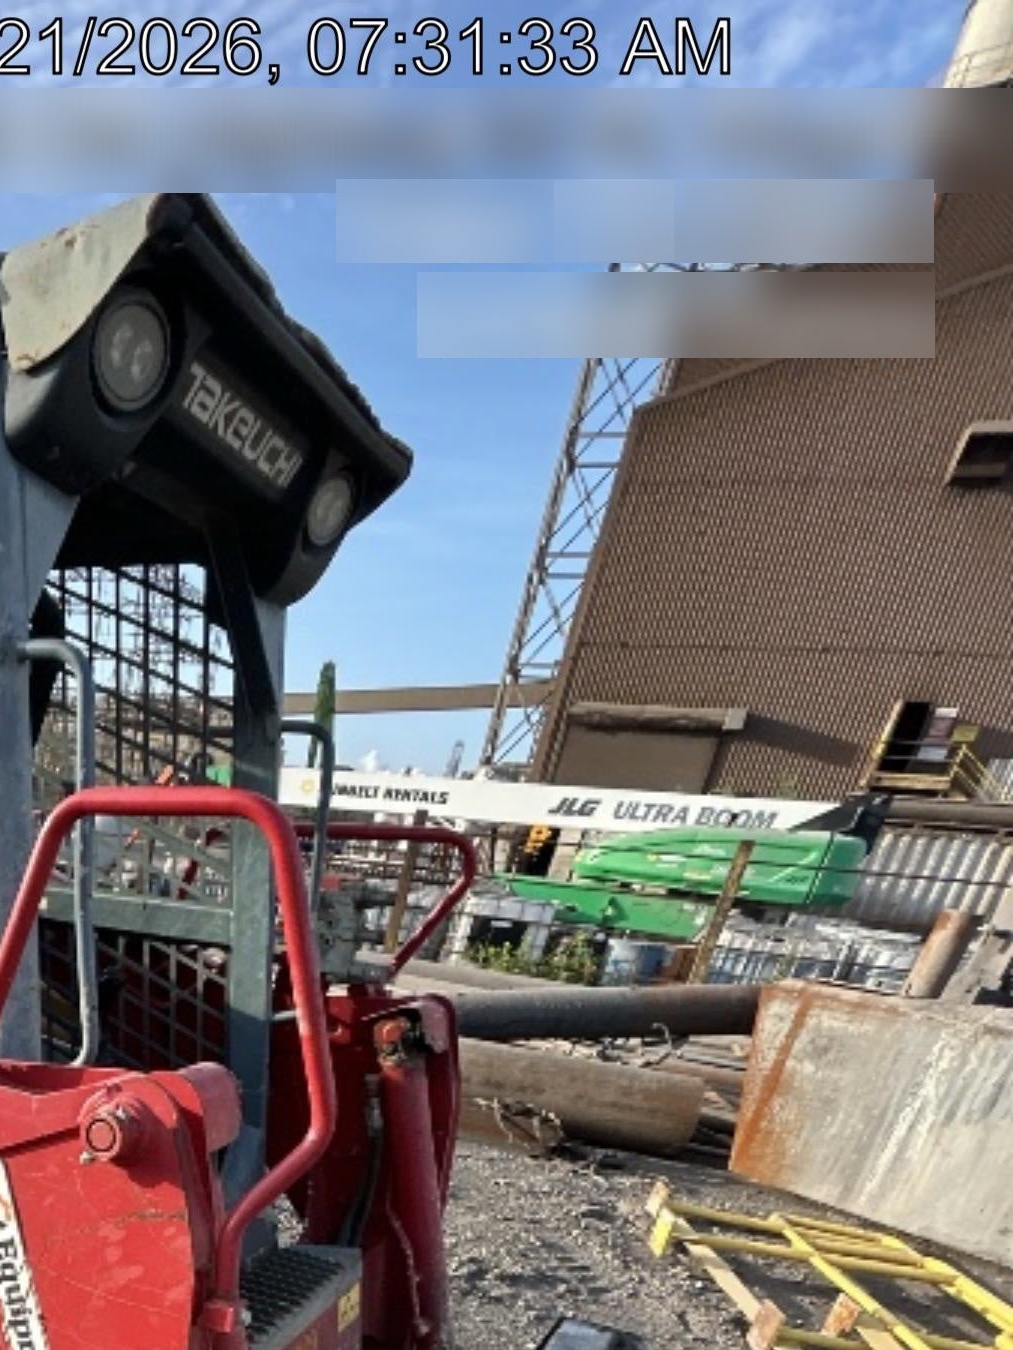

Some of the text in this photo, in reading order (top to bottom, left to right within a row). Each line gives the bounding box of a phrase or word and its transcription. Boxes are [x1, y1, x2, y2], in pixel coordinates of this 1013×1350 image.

[548, 798, 779, 830] JLG ULTRA BOOM
